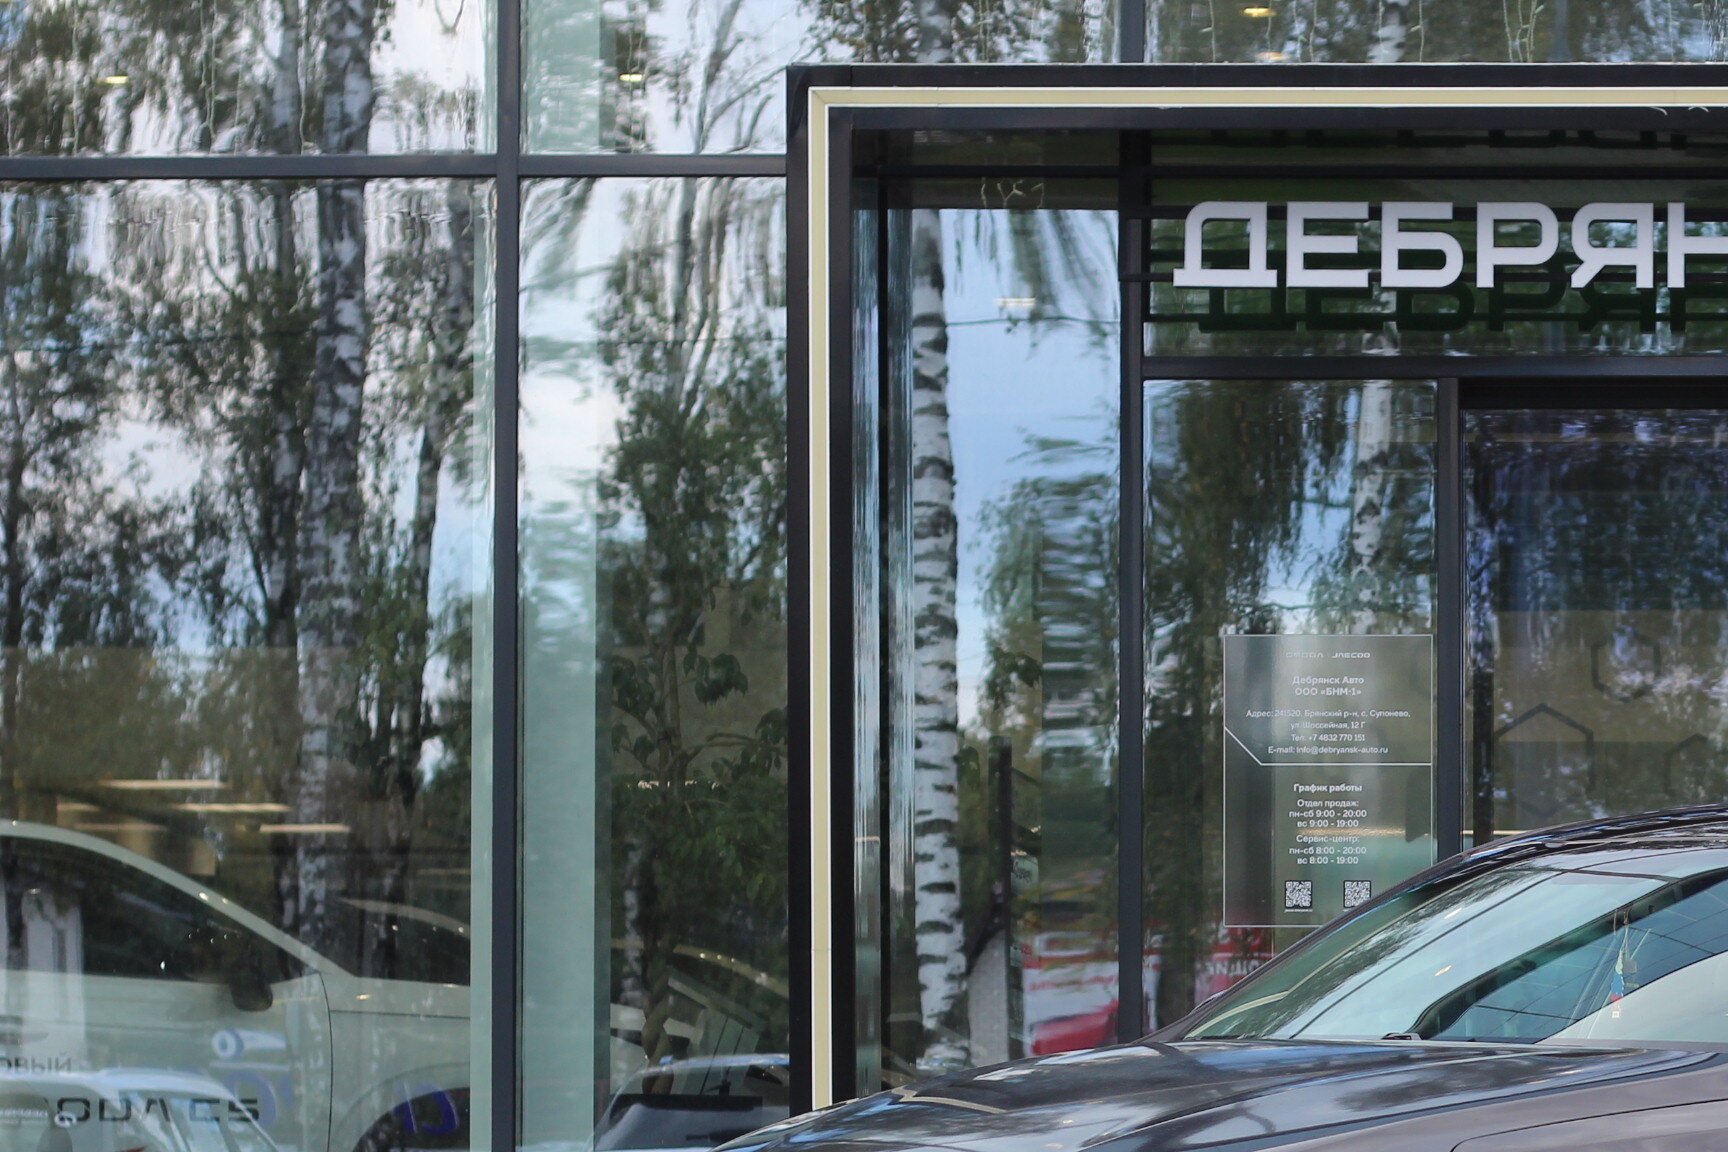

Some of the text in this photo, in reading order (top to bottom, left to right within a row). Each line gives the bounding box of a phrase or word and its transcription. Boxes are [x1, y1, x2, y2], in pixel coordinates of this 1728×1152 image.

[1292, 676, 1365, 686] Дебрянск Авто
[1294, 687, 1318, 696] ООО
[1246, 709, 1274, 718] Адрес:
[1304, 709, 1343, 718] Брянский
[1369, 709, 1411, 718] Супонево,
[1351, 721, 1360, 729] 12
[1318, 734, 1337, 742] 4832
[1338, 734, 1353, 742] 770
[1354, 734, 1366, 742] 151
[1268, 746, 1389, 755] E-mail: info@debryansk-auto.ru
[1293, 783, 1362, 793] График работы
[1297, 799, 1359, 808] Отдел продаж:
[1288, 810, 1314, 818] пн-сб
[1316, 809, 1335, 818] 9:00
[1342, 809, 1367, 818] 20:00
[1297, 820, 1307, 828] вс
[1309, 819, 1329, 828] 9:00
[1336, 819, 1359, 828] 19:00
[1296, 834, 1360, 843] Сервис-центр:
[1289, 846, 1314, 854] пн-сб
[1316, 846, 1335, 854] 8:00
[1342, 846, 1367, 854] 20:00
[1309, 856, 1329, 864] 8:00
[1336, 856, 1359, 864] 19:00
